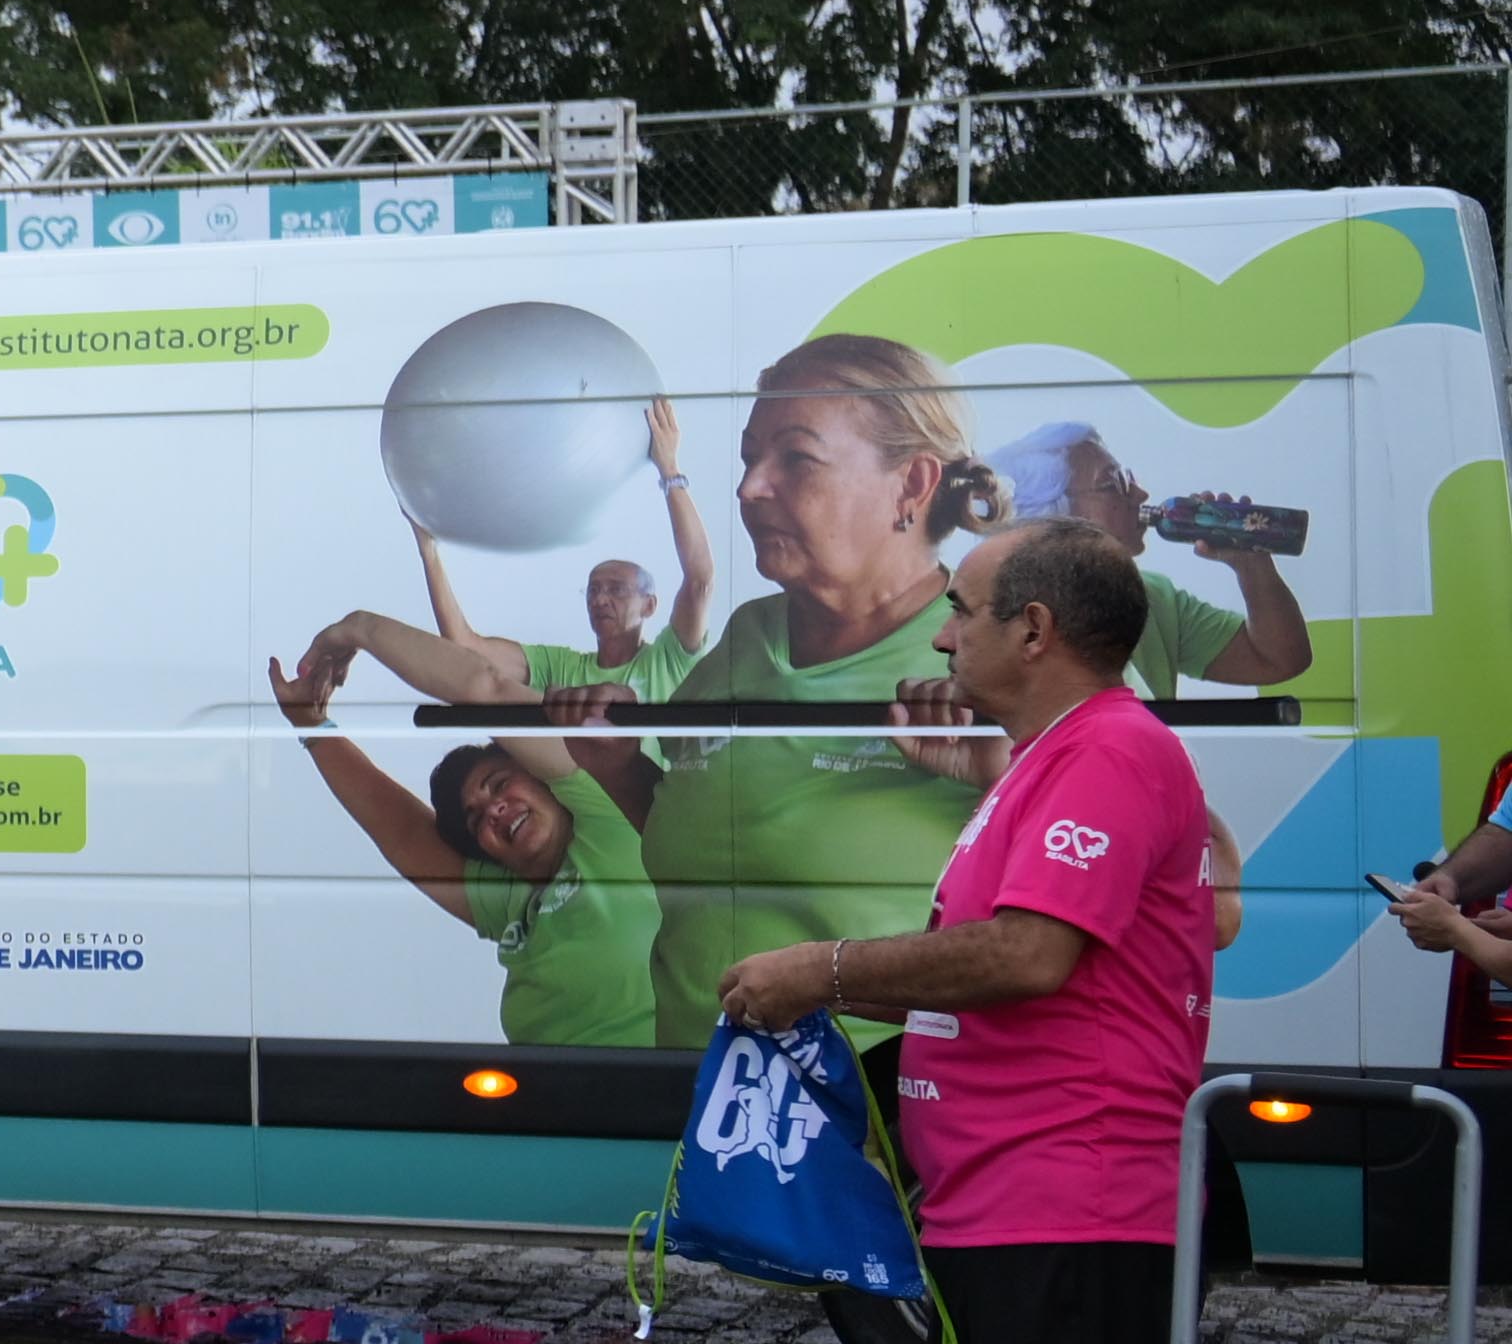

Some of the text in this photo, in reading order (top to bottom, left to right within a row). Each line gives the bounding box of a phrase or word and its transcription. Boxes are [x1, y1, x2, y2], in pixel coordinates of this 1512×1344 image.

[25, 932, 51, 944] DO
[63, 933, 145, 945] ESTADO
[18, 948, 145, 971] JANEIRO
